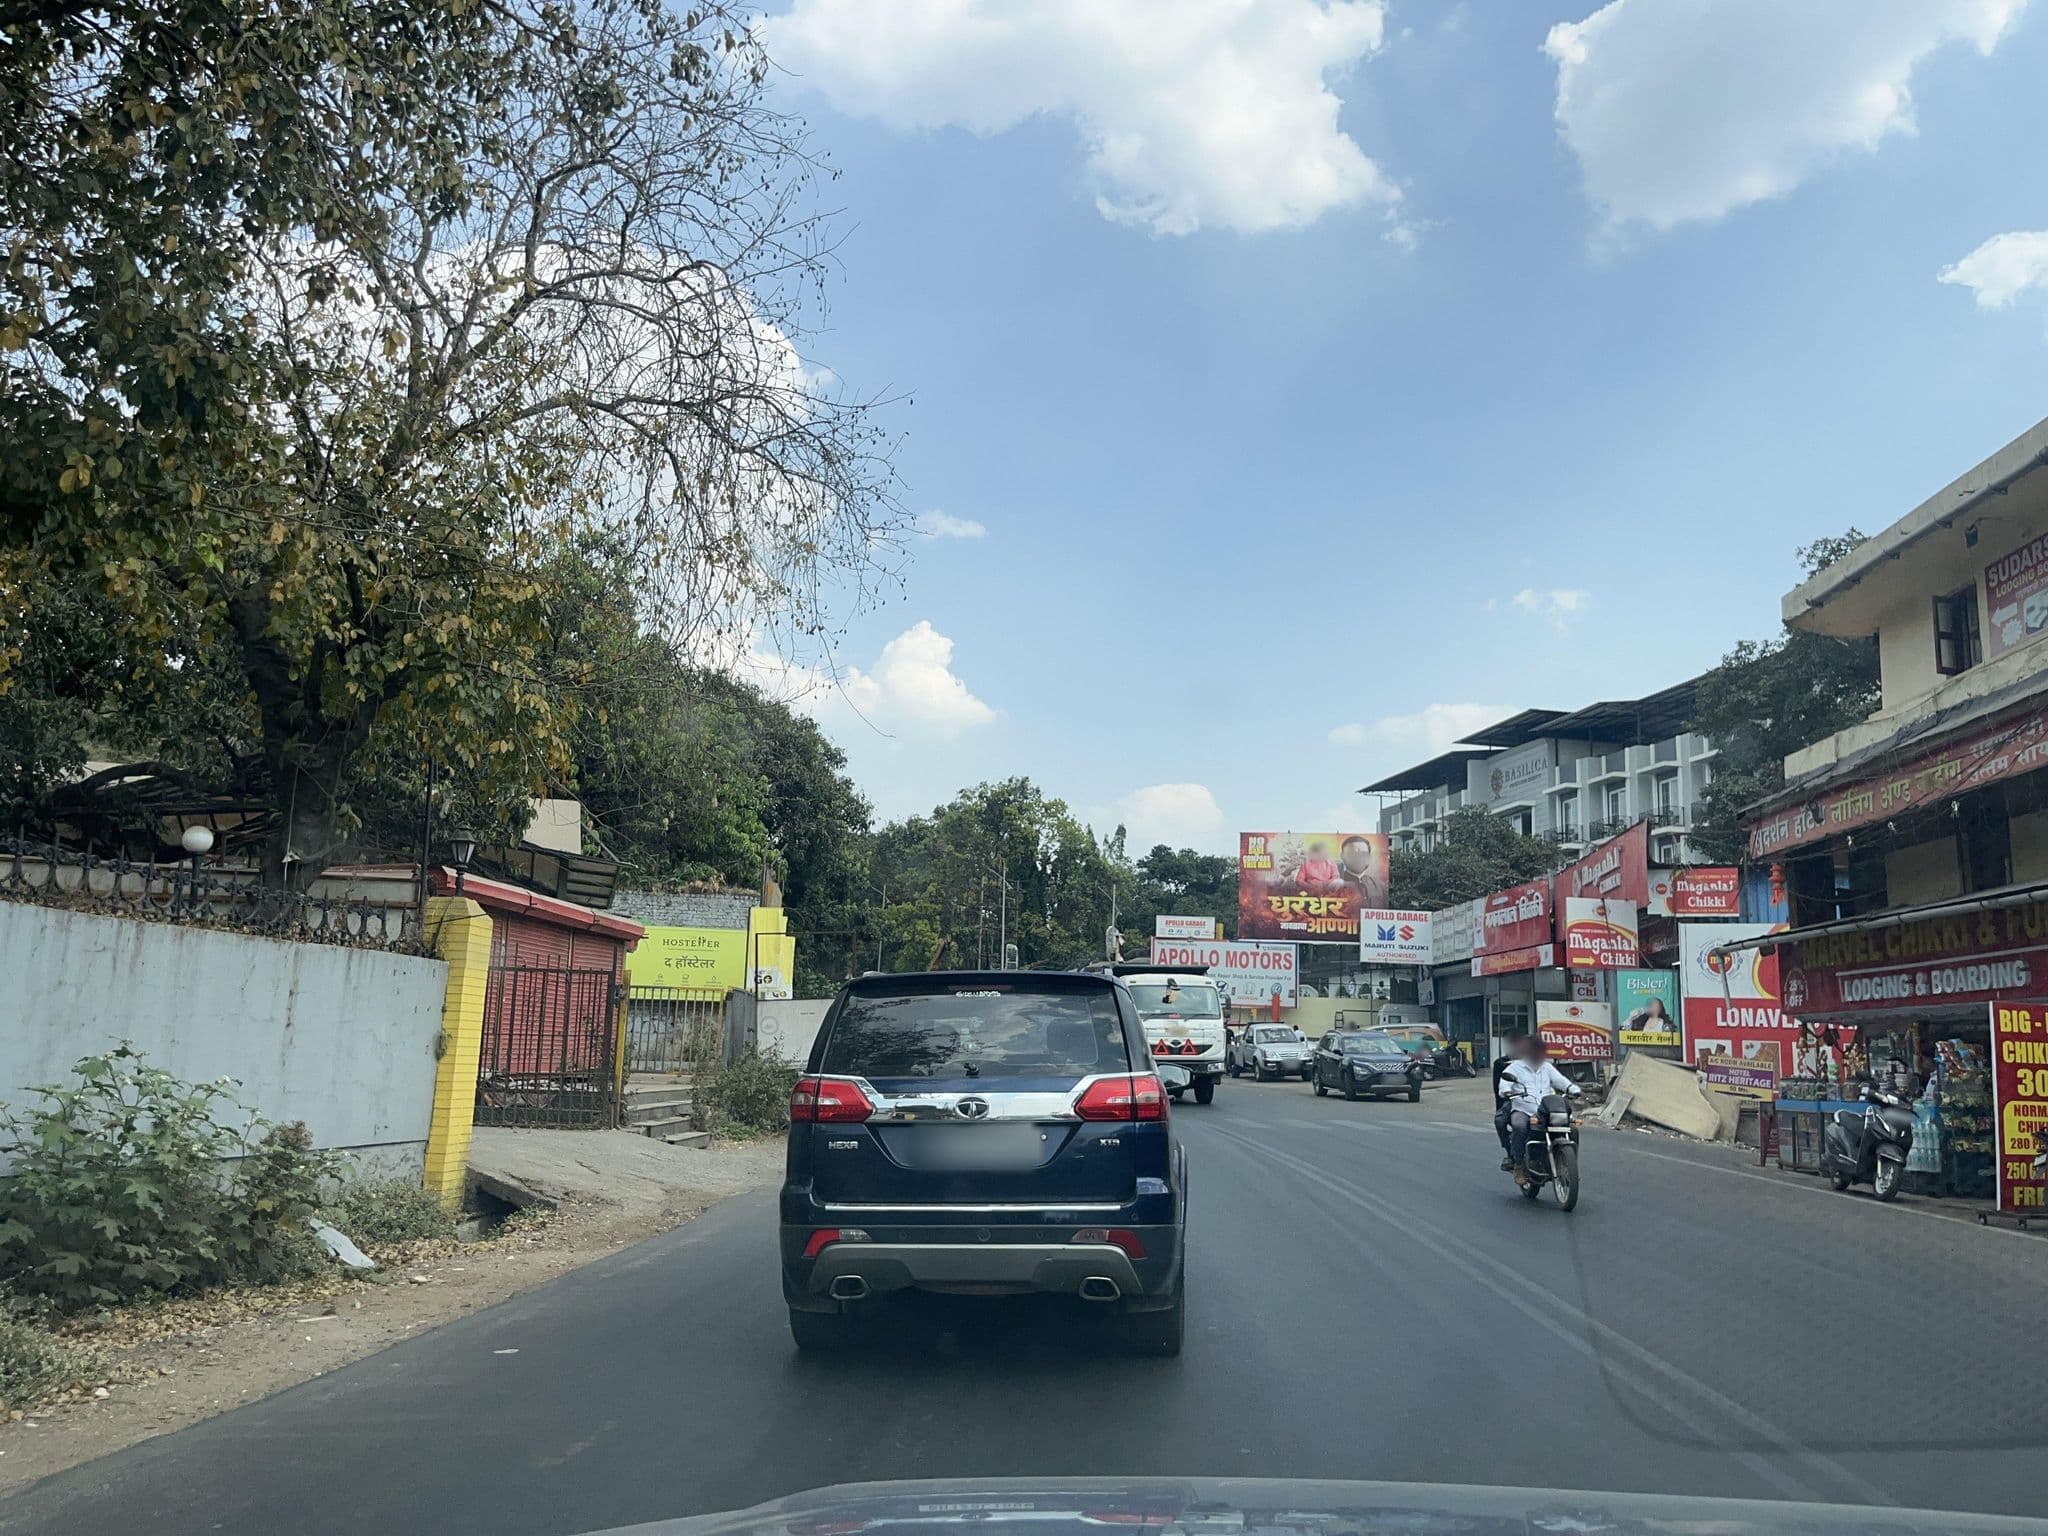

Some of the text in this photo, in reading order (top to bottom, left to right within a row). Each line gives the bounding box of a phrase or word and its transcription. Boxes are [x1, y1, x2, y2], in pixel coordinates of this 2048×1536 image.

[1996, 567, 2035, 598] LODGING
[1504, 757, 1548, 782] BASILICA
[1676, 880, 1734, 895] Maganlal
[1268, 890, 1348, 922] धुरंधर
[1687, 896, 1726, 908] Chikki
[1365, 911, 1429, 922] APOLLO GARAGE
[1569, 932, 1637, 954] Maganlal
[664, 955, 716, 969] द हॉस्टेलर
[1158, 947, 1293, 971] APOLLO MOTORS
[1600, 953, 1636, 966] Chikki
[1844, 959, 2028, 1002] LODGING & BOARDING
[1999, 1009, 2032, 1034] BIG
[1541, 1031, 1612, 1047] Maganlal
[1572, 1046, 1612, 1057] Chikki
[1738, 1060, 1772, 1069] AVAILABLE
[1709, 1073, 1772, 1089] RITZ HERITAGE
[1728, 1069, 1751, 1077] HOTEL
[2010, 1137, 2030, 1150] 280
[2006, 1161, 2027, 1180] 250
